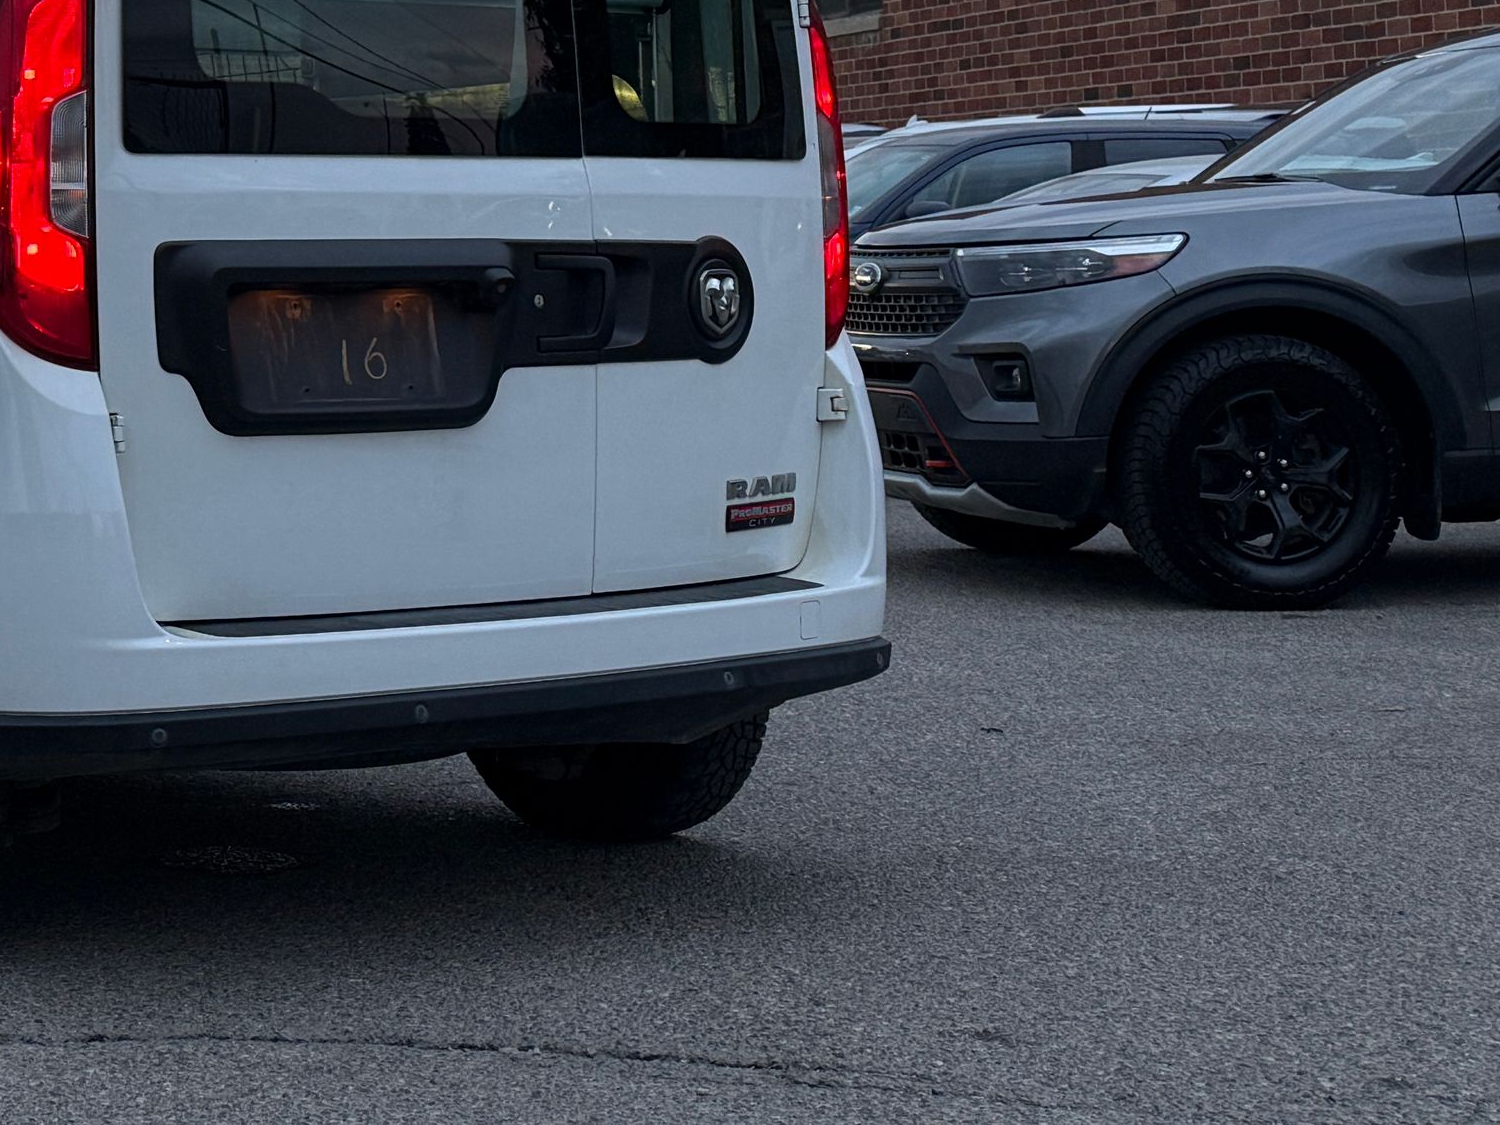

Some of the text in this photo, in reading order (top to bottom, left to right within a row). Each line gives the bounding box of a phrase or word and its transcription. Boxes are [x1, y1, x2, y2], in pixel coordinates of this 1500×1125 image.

[341, 337, 387, 385] 16
[726, 472, 797, 501] RAM
[748, 517, 776, 527] CITY
